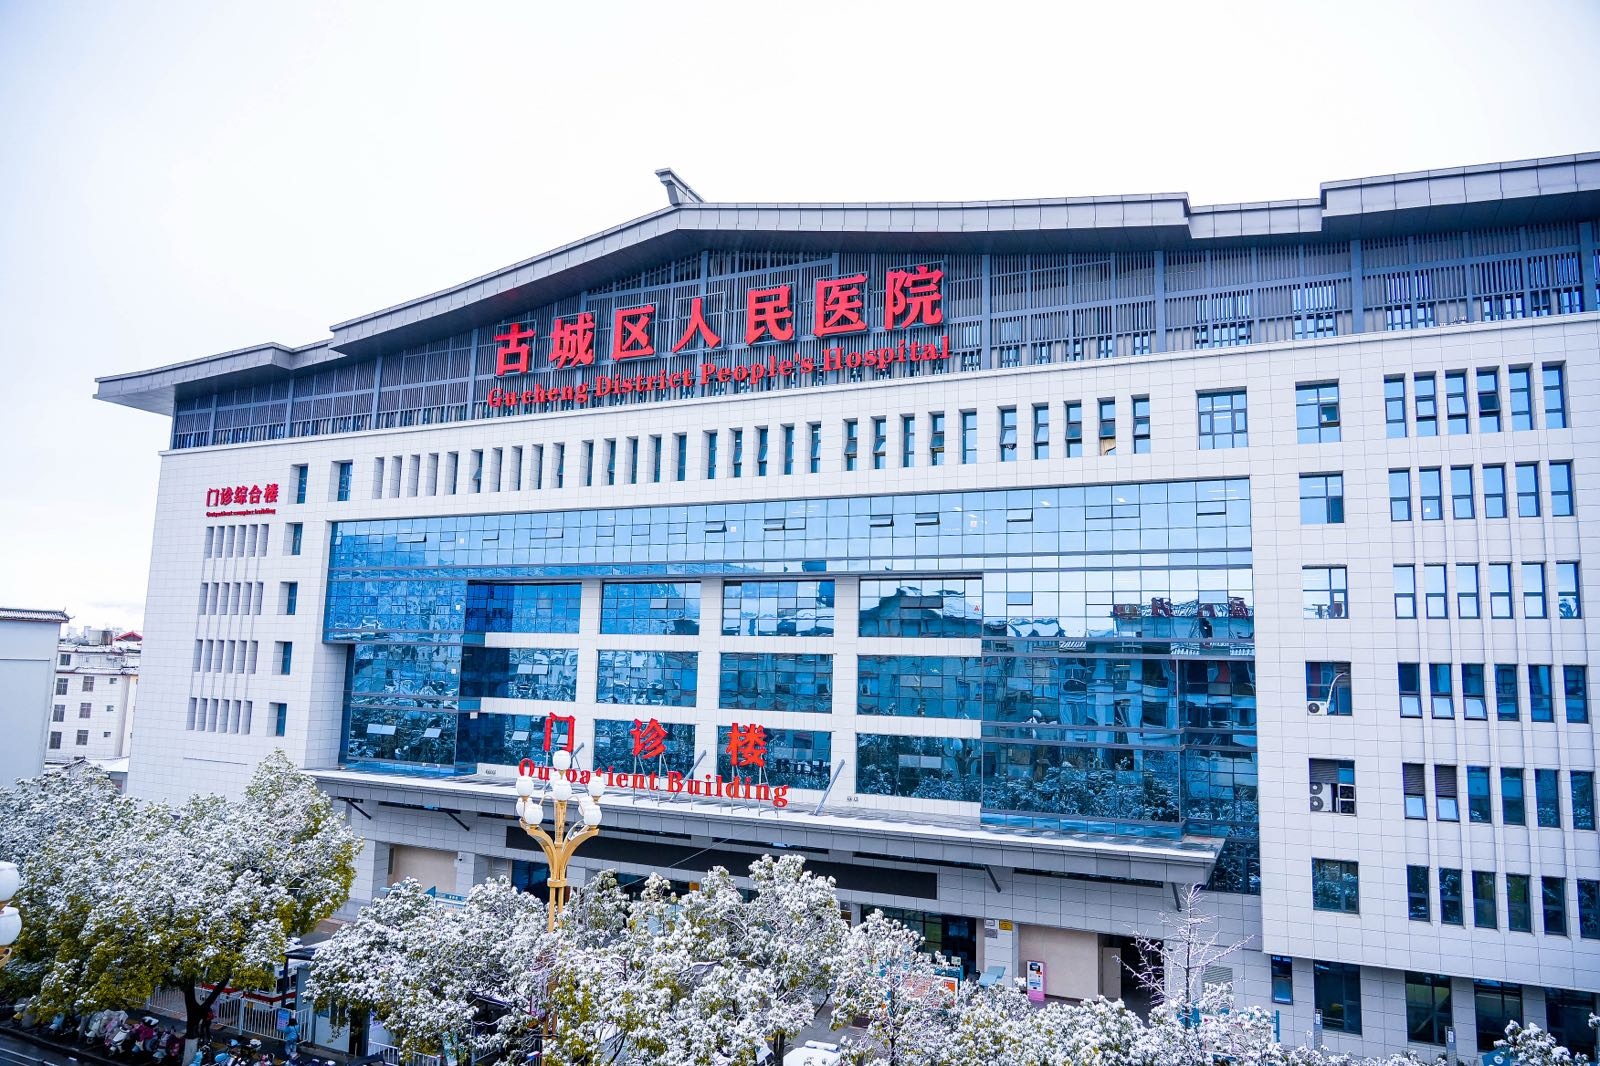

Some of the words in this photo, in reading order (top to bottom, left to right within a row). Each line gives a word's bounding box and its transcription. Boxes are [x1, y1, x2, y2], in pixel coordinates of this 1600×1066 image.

[493, 265, 945, 377] 古城区人民医院
[594, 367, 695, 397] District
[699, 352, 815, 385] People's
[822, 335, 951, 372] Hospital
[206, 483, 279, 507] 门诊综合楼
[543, 711, 767, 768] 门诊楼
[667, 770, 789, 807] Building
